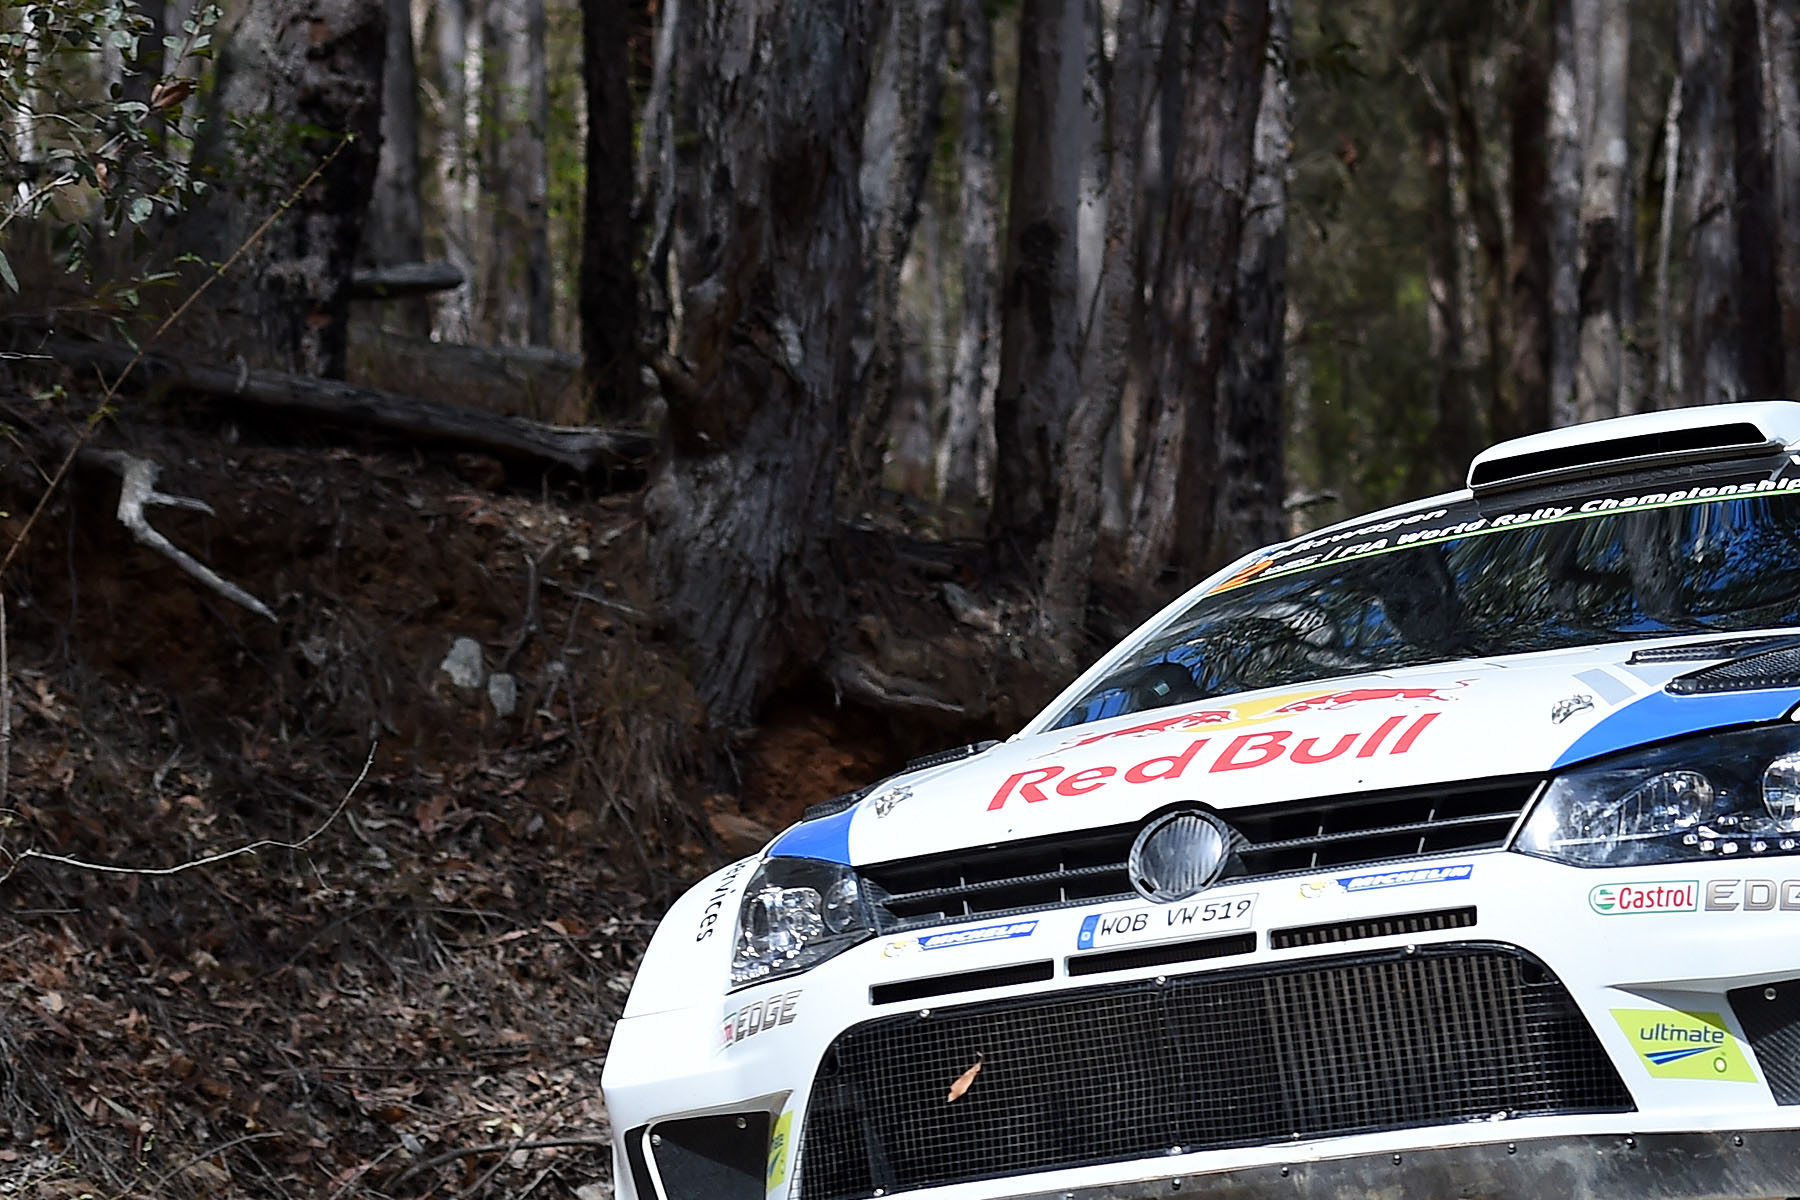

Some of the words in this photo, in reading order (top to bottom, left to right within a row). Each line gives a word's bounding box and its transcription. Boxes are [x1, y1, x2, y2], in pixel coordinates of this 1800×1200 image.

[1338, 537, 1390, 558] FIA
[1397, 518, 1487, 545] World
[1490, 506, 1573, 529] Rally
[986, 738, 1209, 811] Red
[1208, 711, 1442, 774] Bull
[1348, 865, 1472, 888] MICHELIN
[1618, 884, 1693, 910] Castrol
[1100, 913, 1149, 937] WOB
[734, 989, 804, 1043] EDGE
[1639, 1022, 1725, 1044] ultimate
